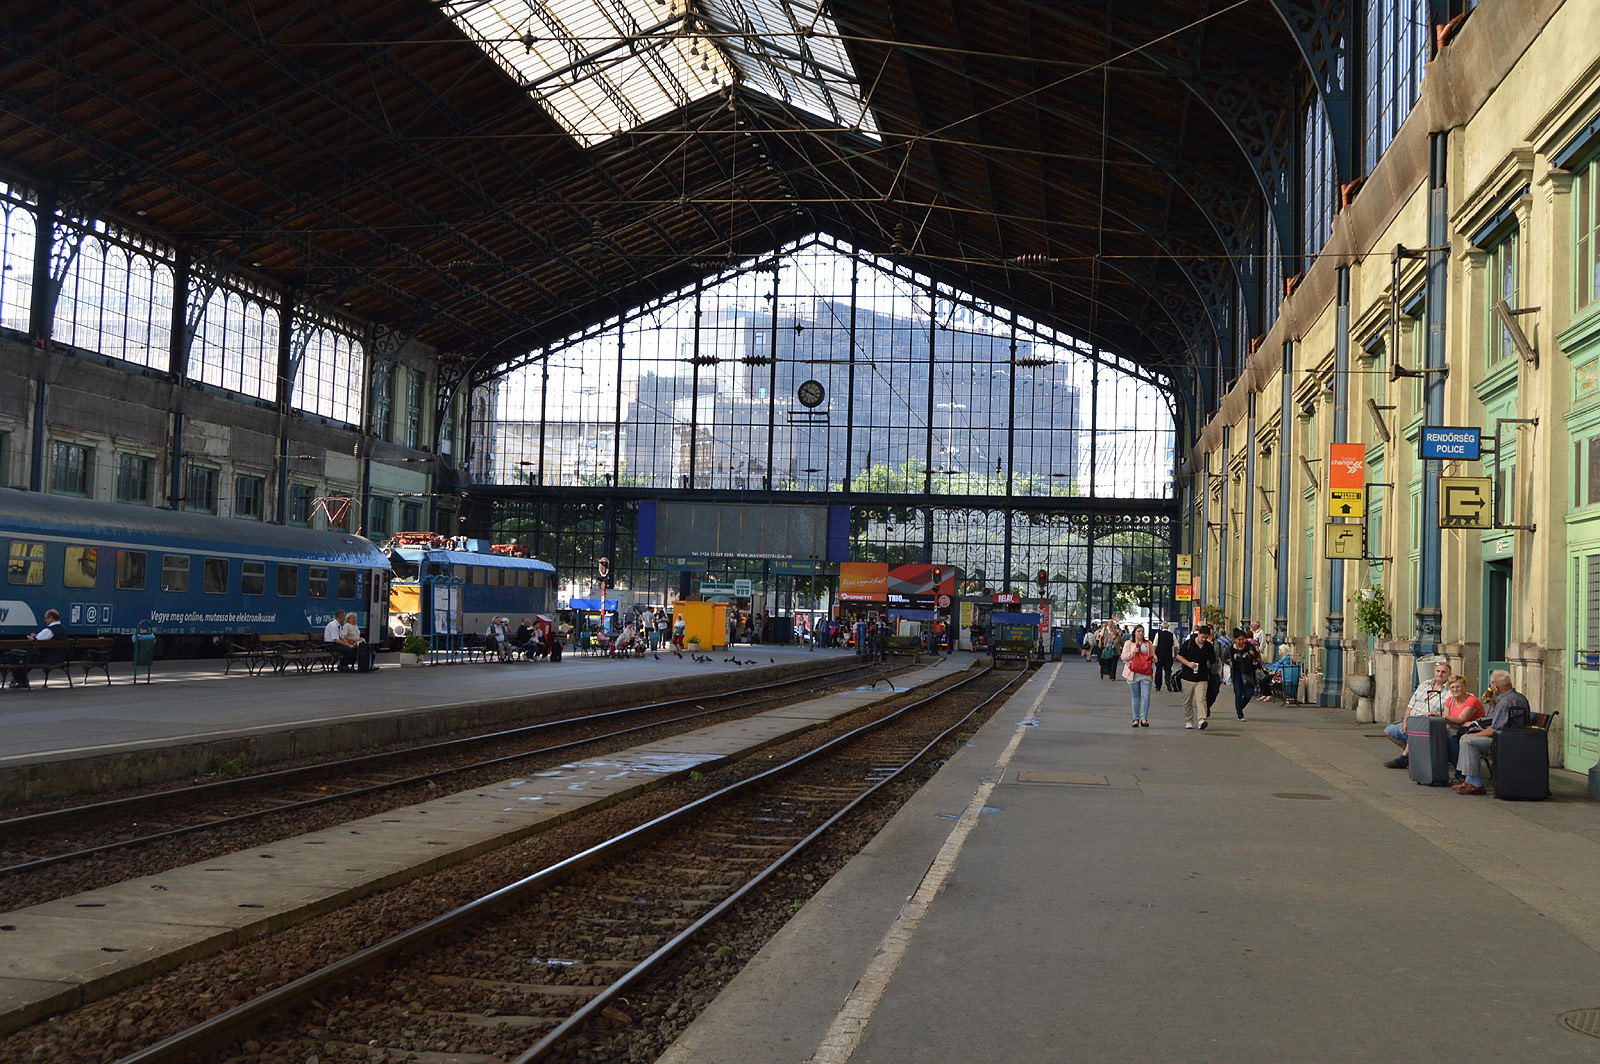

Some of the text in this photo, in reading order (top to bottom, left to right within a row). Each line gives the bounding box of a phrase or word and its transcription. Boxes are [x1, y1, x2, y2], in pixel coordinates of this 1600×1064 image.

[1426, 432, 1475, 443] RENDŐRSÉG
[1436, 444, 1465, 454] POLICE
[888, 594, 902, 603] TRIO
[998, 594, 1014, 602] RELAY
[151, 610, 276, 623] Vegye meg online, mutassa be elektronikusan!
